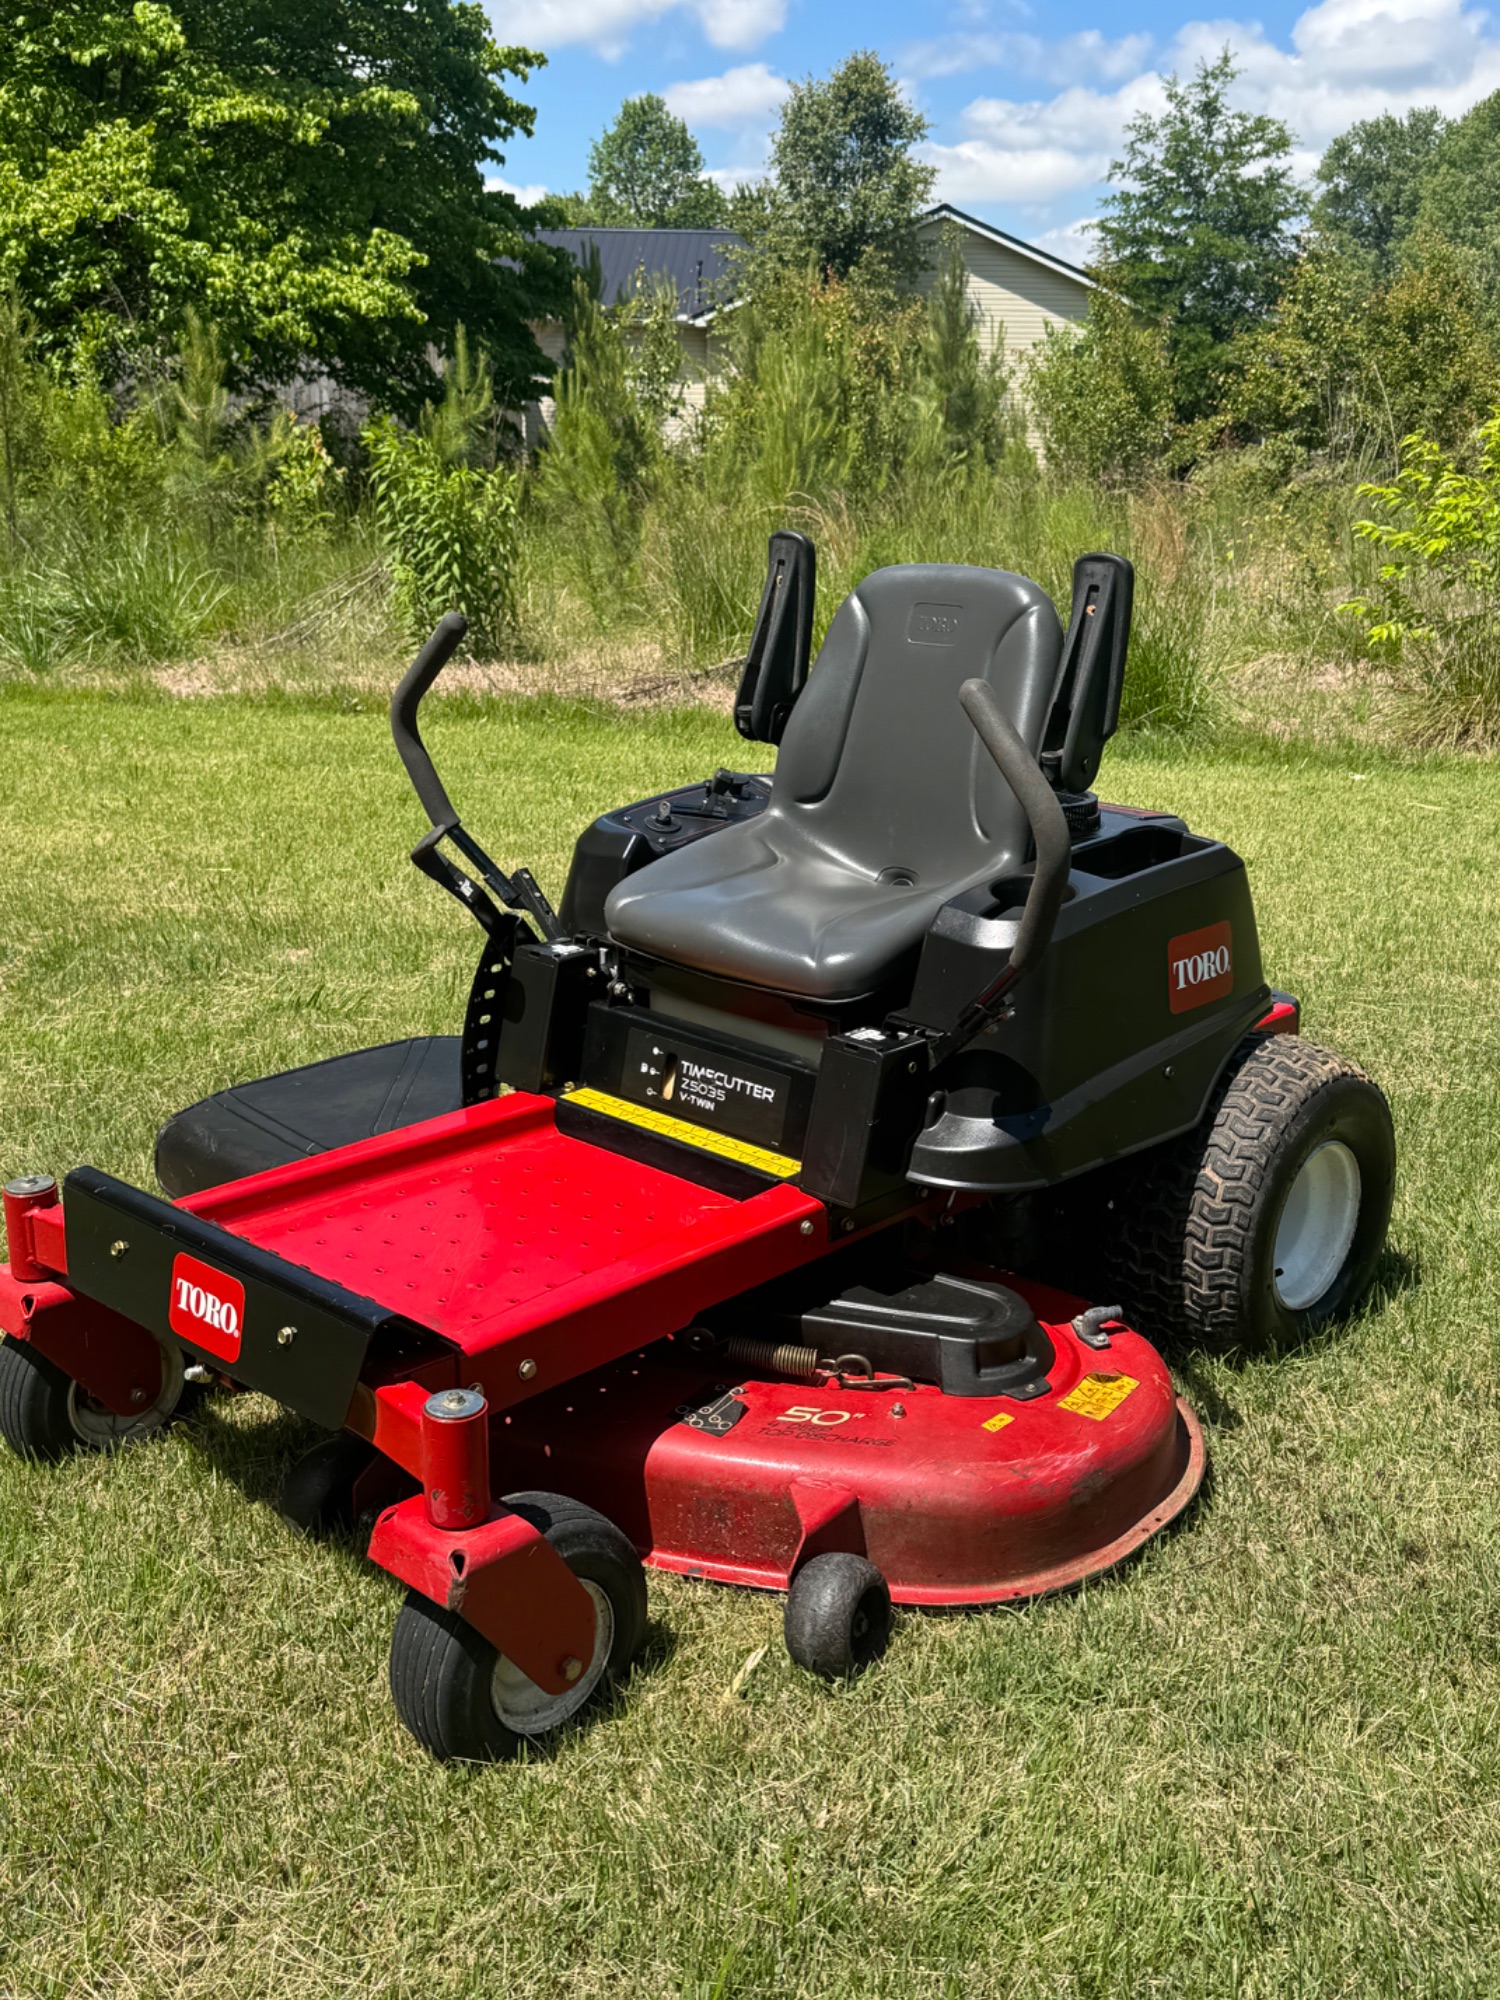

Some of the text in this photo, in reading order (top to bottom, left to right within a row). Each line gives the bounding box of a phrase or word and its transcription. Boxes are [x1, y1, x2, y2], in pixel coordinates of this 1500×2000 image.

[916, 615, 958, 632] TORO
[1173, 945, 1229, 990] TORO
[681, 1060, 775, 1103] TIMECUTTER
[681, 1077, 726, 1101] Z5035
[680, 1091, 715, 1111] V-TWIN
[176, 1277, 239, 1336] TORO
[776, 1406, 865, 1426] 50"
[757, 1428, 897, 1447] TOP DISCHARGE
